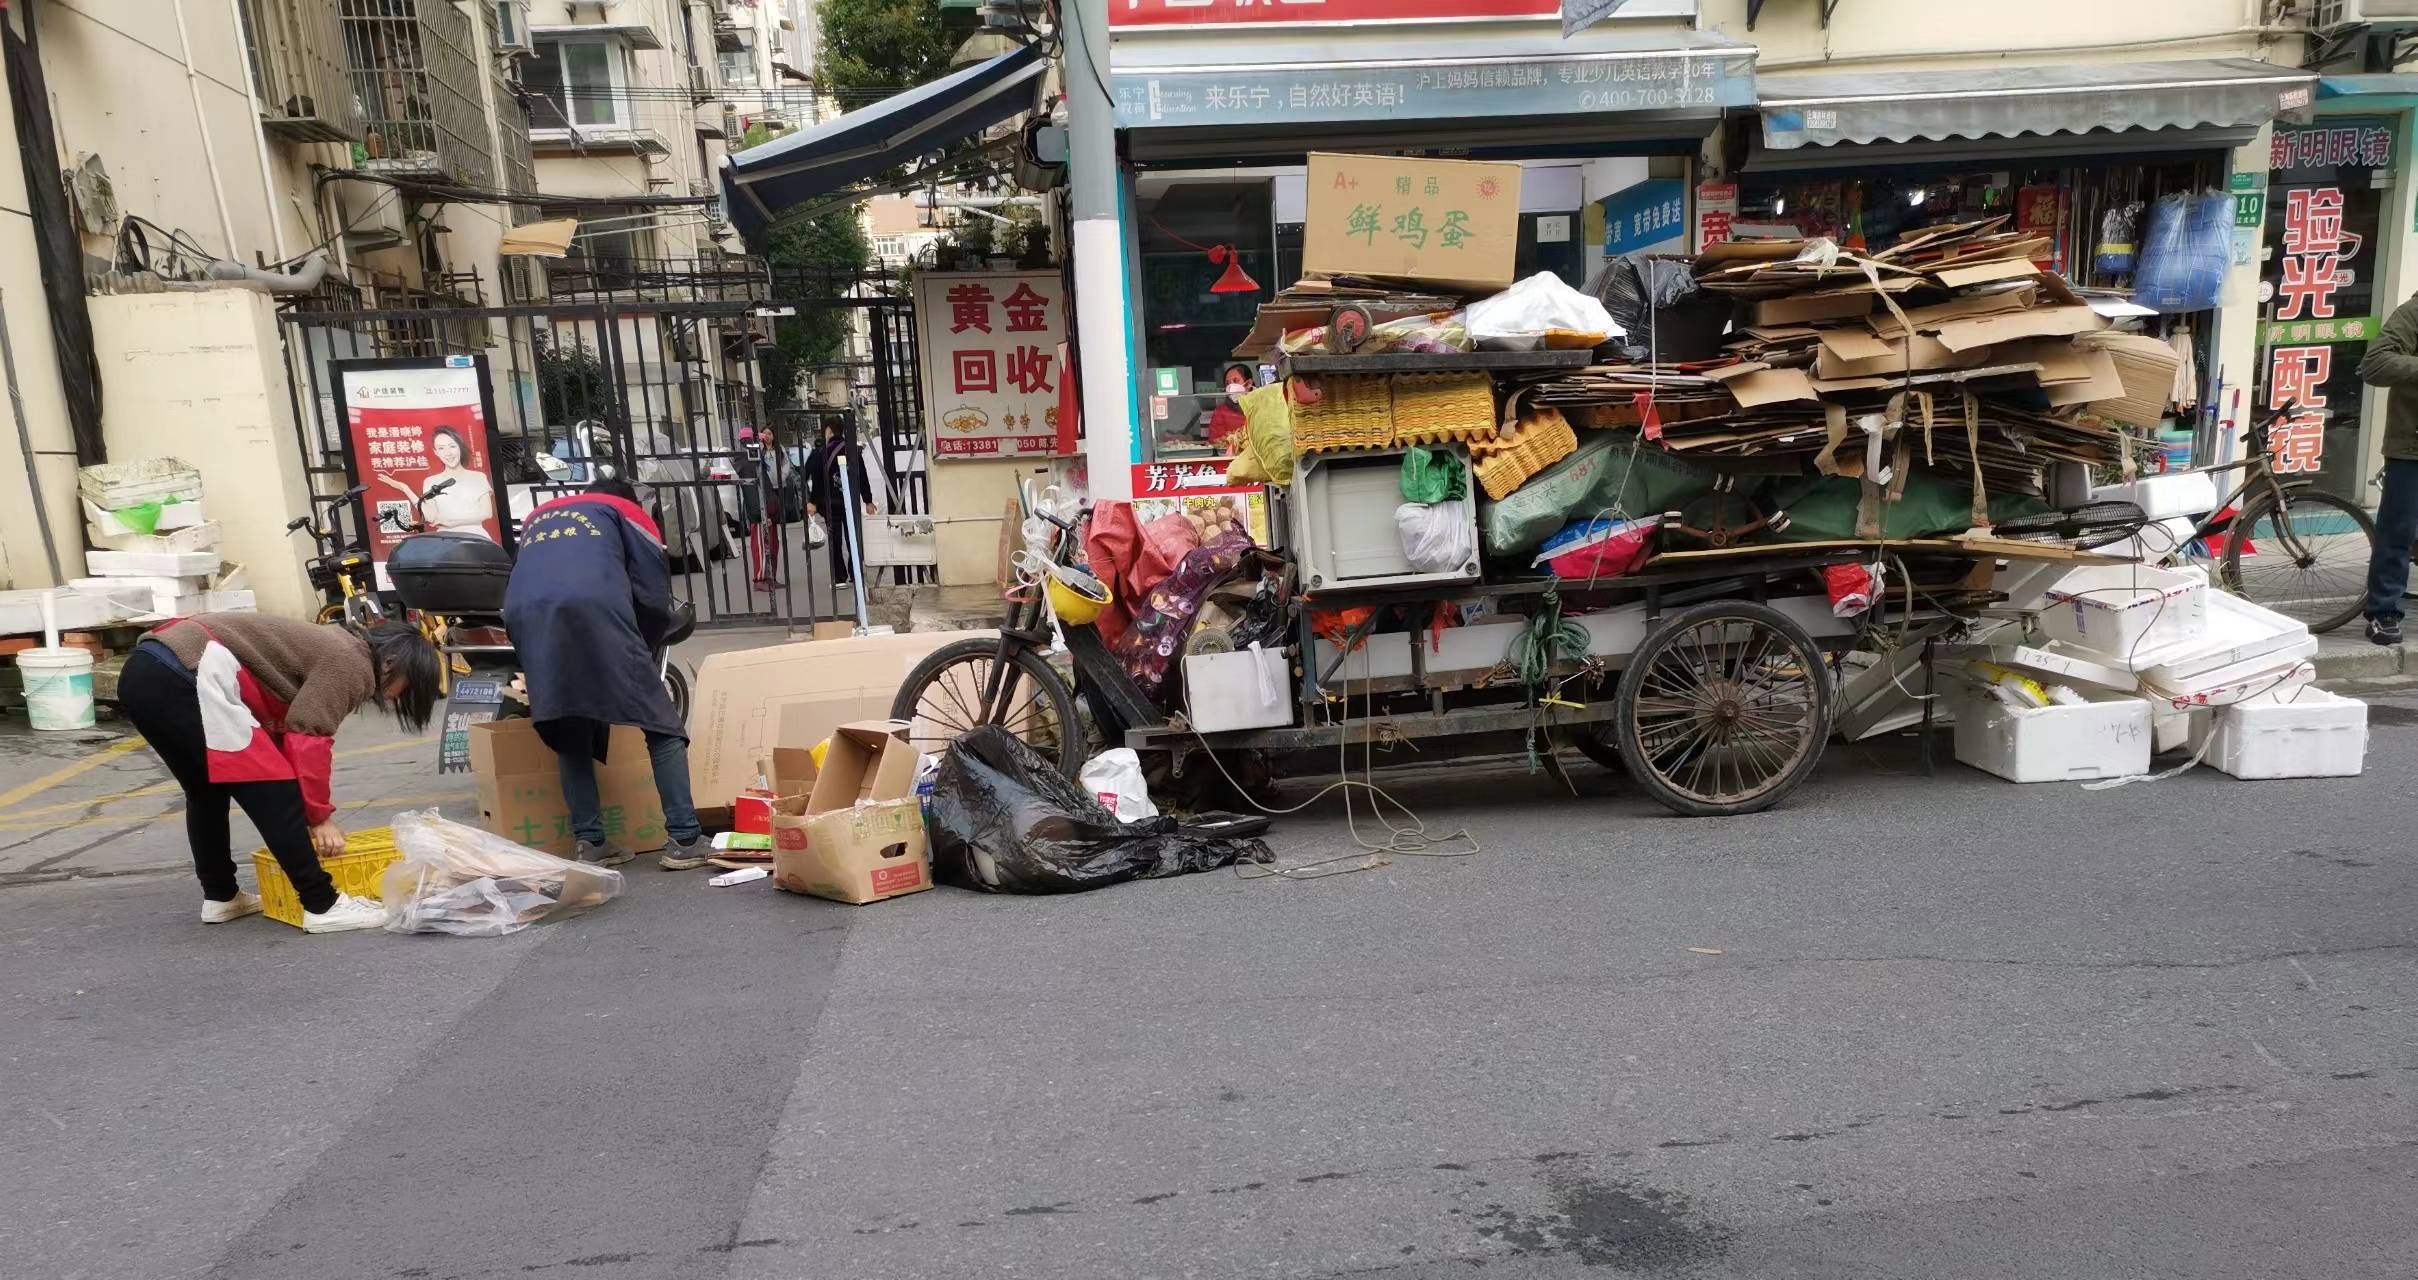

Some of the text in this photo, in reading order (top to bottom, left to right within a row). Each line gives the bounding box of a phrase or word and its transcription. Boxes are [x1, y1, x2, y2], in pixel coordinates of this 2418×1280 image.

[2270, 127, 2391, 169] 新明眼镜
[1334, 171, 1358, 191] A+
[1396, 175, 1439, 196] 精品
[1346, 203, 1475, 250] 鲜鸡蛋
[1633, 198, 1681, 237] 宽带免费送
[2277, 187, 2344, 320] 验光
[946, 283, 1050, 335] 黄金
[953, 345, 1054, 394] 回收
[2267, 346, 2332, 474] 配镜
[368, 441, 425, 455] 家庭装修
[371, 456, 429, 469] 我推荐沪佳
[1184, 496, 1216, 507] 牛肉丸
